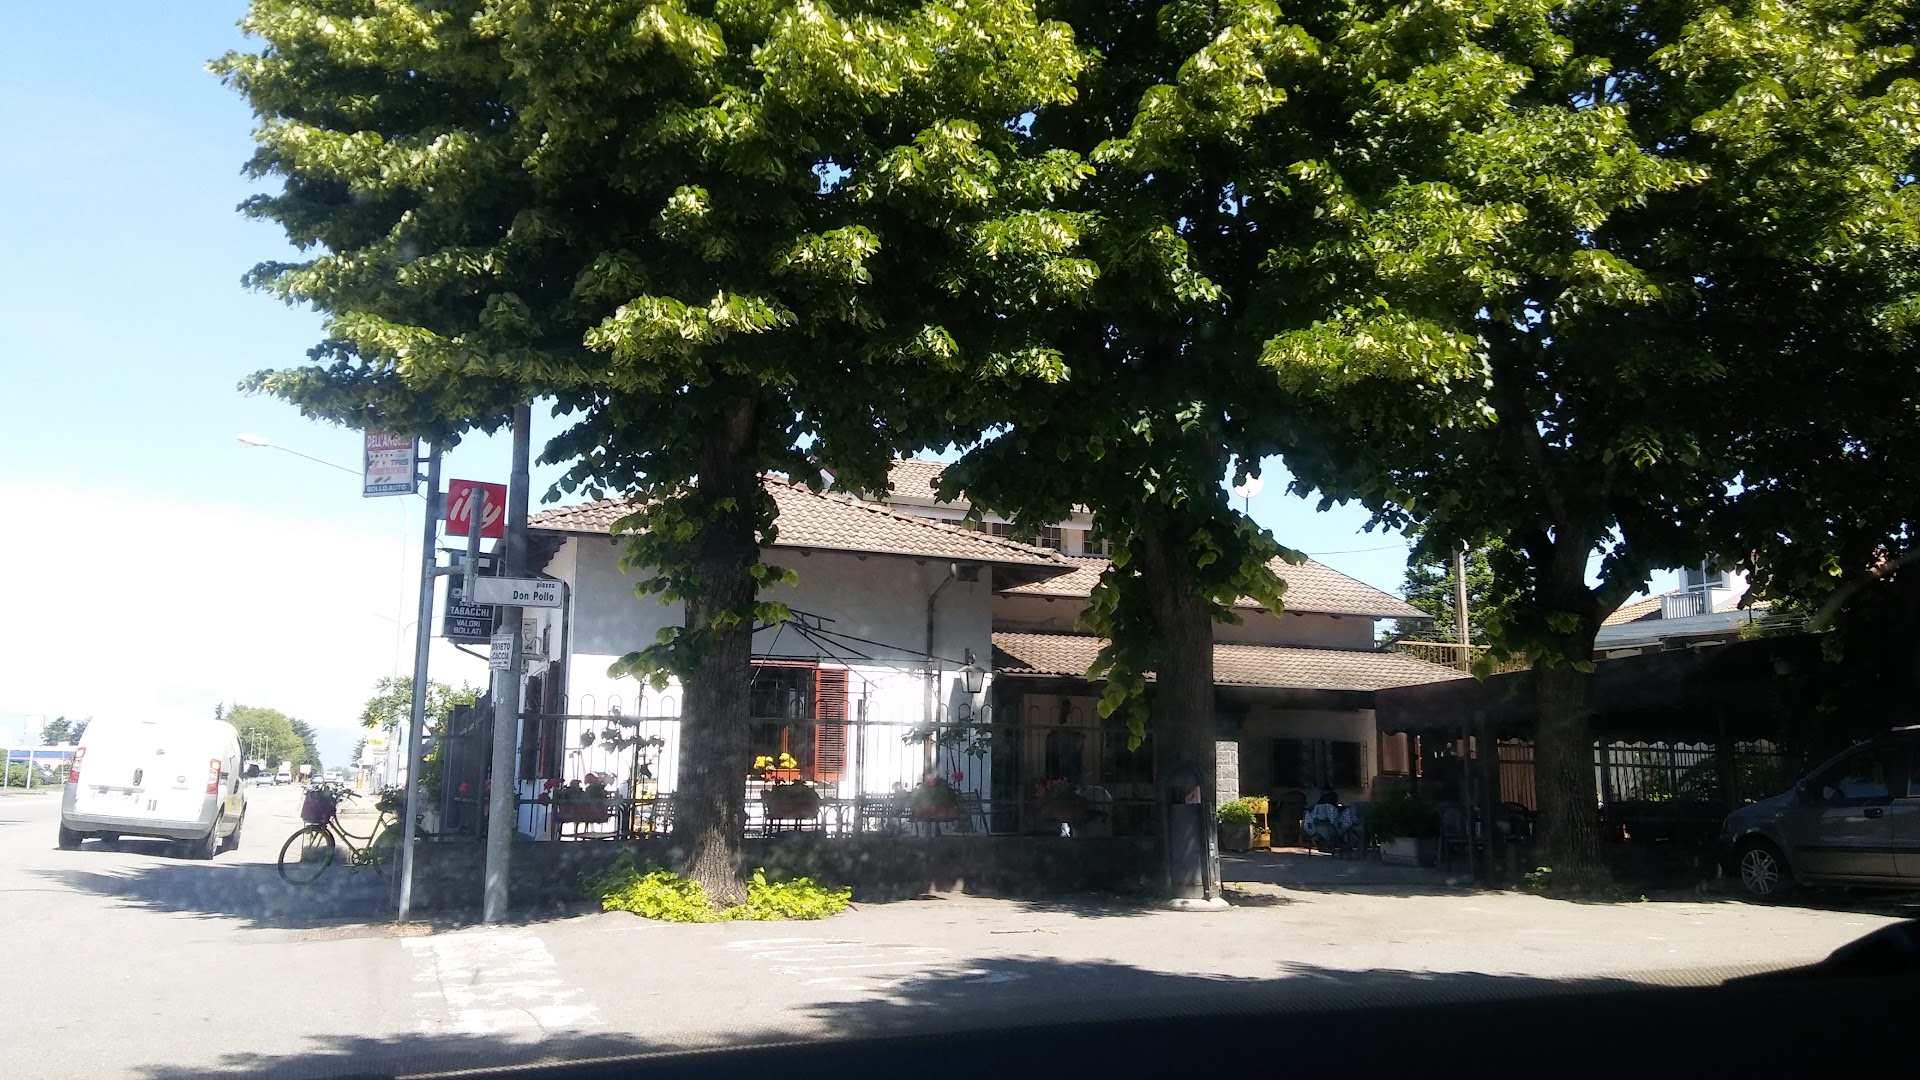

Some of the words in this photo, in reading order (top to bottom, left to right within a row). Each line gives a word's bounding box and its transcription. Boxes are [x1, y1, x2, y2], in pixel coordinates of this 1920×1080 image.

[513, 590, 529, 600] Don
[533, 591, 554, 601] Pollo
[450, 606, 490, 617] TABACCHI
[456, 619, 481, 627] VALORI
[453, 626, 482, 635] BOLLATI
[491, 642, 511, 651] DIVIETO
